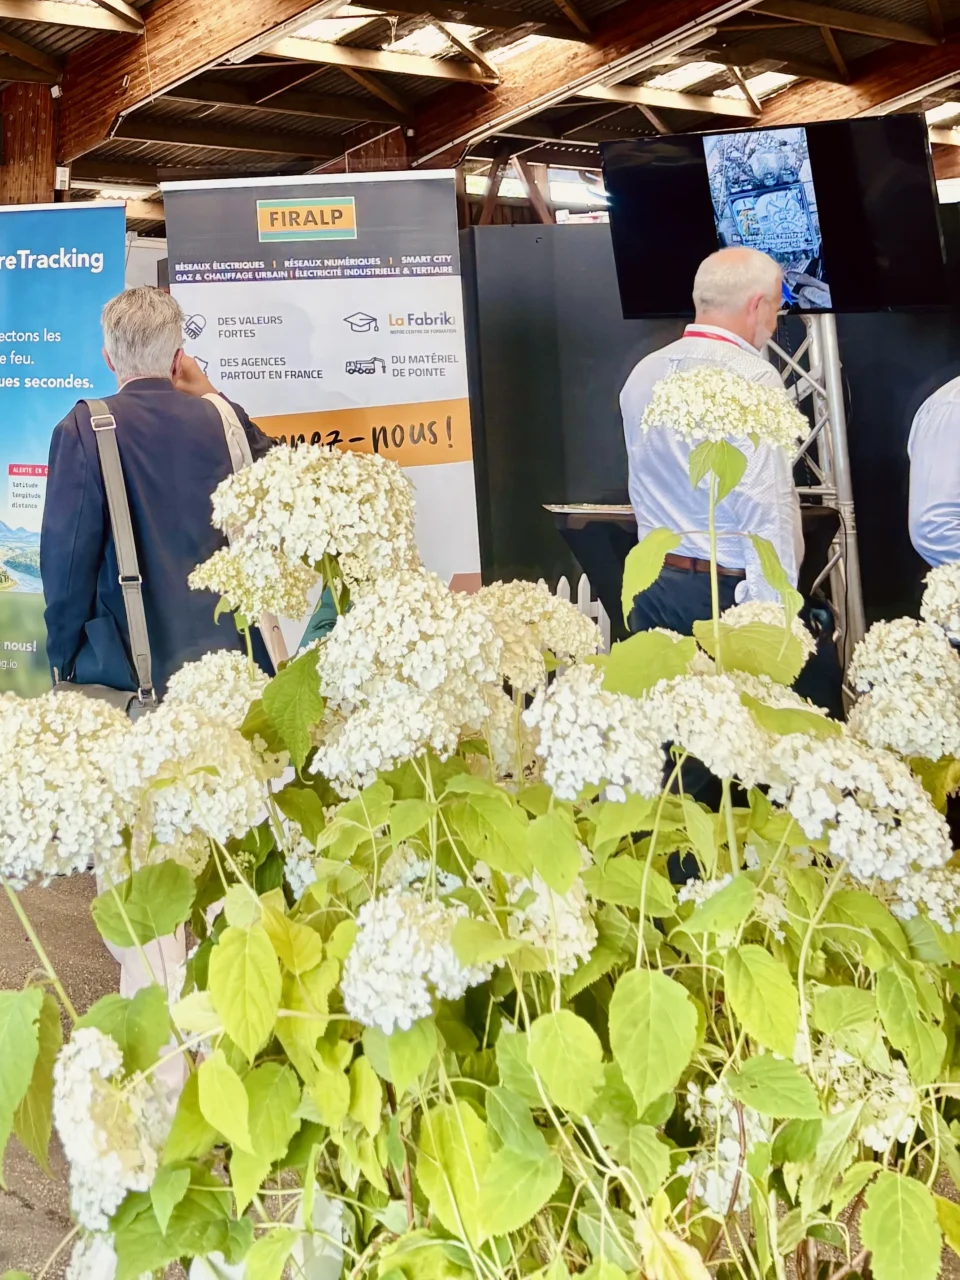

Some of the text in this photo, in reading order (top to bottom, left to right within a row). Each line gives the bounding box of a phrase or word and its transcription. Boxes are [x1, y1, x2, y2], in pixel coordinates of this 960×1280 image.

[269, 209, 343, 227] FIRALP
[175, 254, 452, 271] RÉSEAUX ÉLECTRIQUES RÉSEAUX NUMÉRIQUES SMART CITY
[175, 265, 453, 282] GAZ & CHAUFFAGE URBAIN ÉLECTRICITÉ INDUSTRIELLE & TERTIAIRE
[217, 315, 283, 326] DES VALEURS
[388, 313, 405, 326] La
[43, 327, 61, 342] les
[218, 329, 256, 338] FORTES
[10, 350, 35, 365] feu.
[220, 357, 286, 367] DES AGENCES
[391, 353, 459, 365] DU MATÉRIEL
[221, 369, 323, 380] PARTOUT EN FRANCE
[392, 367, 446, 378] DE POINTE
[24, 373, 94, 389] secondes.
[3, 639, 37, 652] nous!
